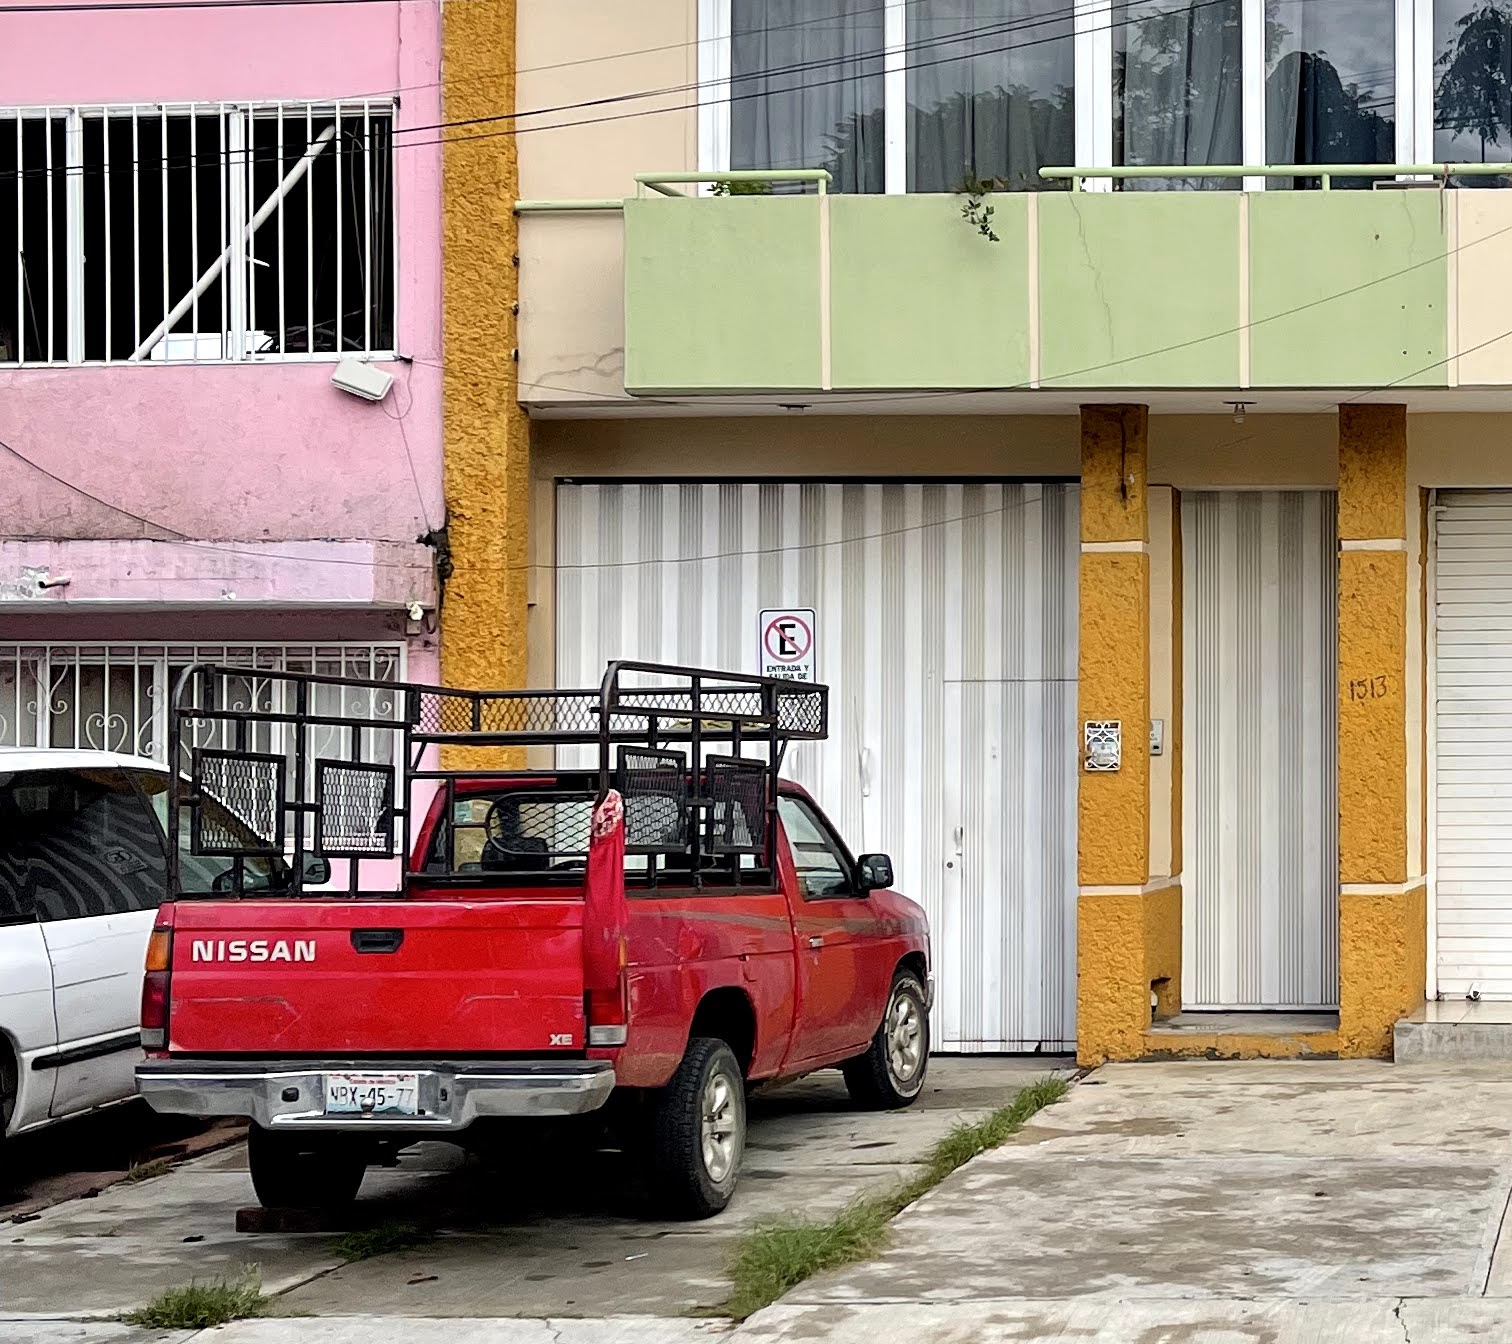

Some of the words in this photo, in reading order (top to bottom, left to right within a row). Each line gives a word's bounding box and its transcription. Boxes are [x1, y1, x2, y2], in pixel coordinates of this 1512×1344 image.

[779, 624, 797, 656] E
[1350, 675, 1387, 702] 1513
[192, 940, 316, 962] NISSAN
[549, 1033, 573, 1046] XE
